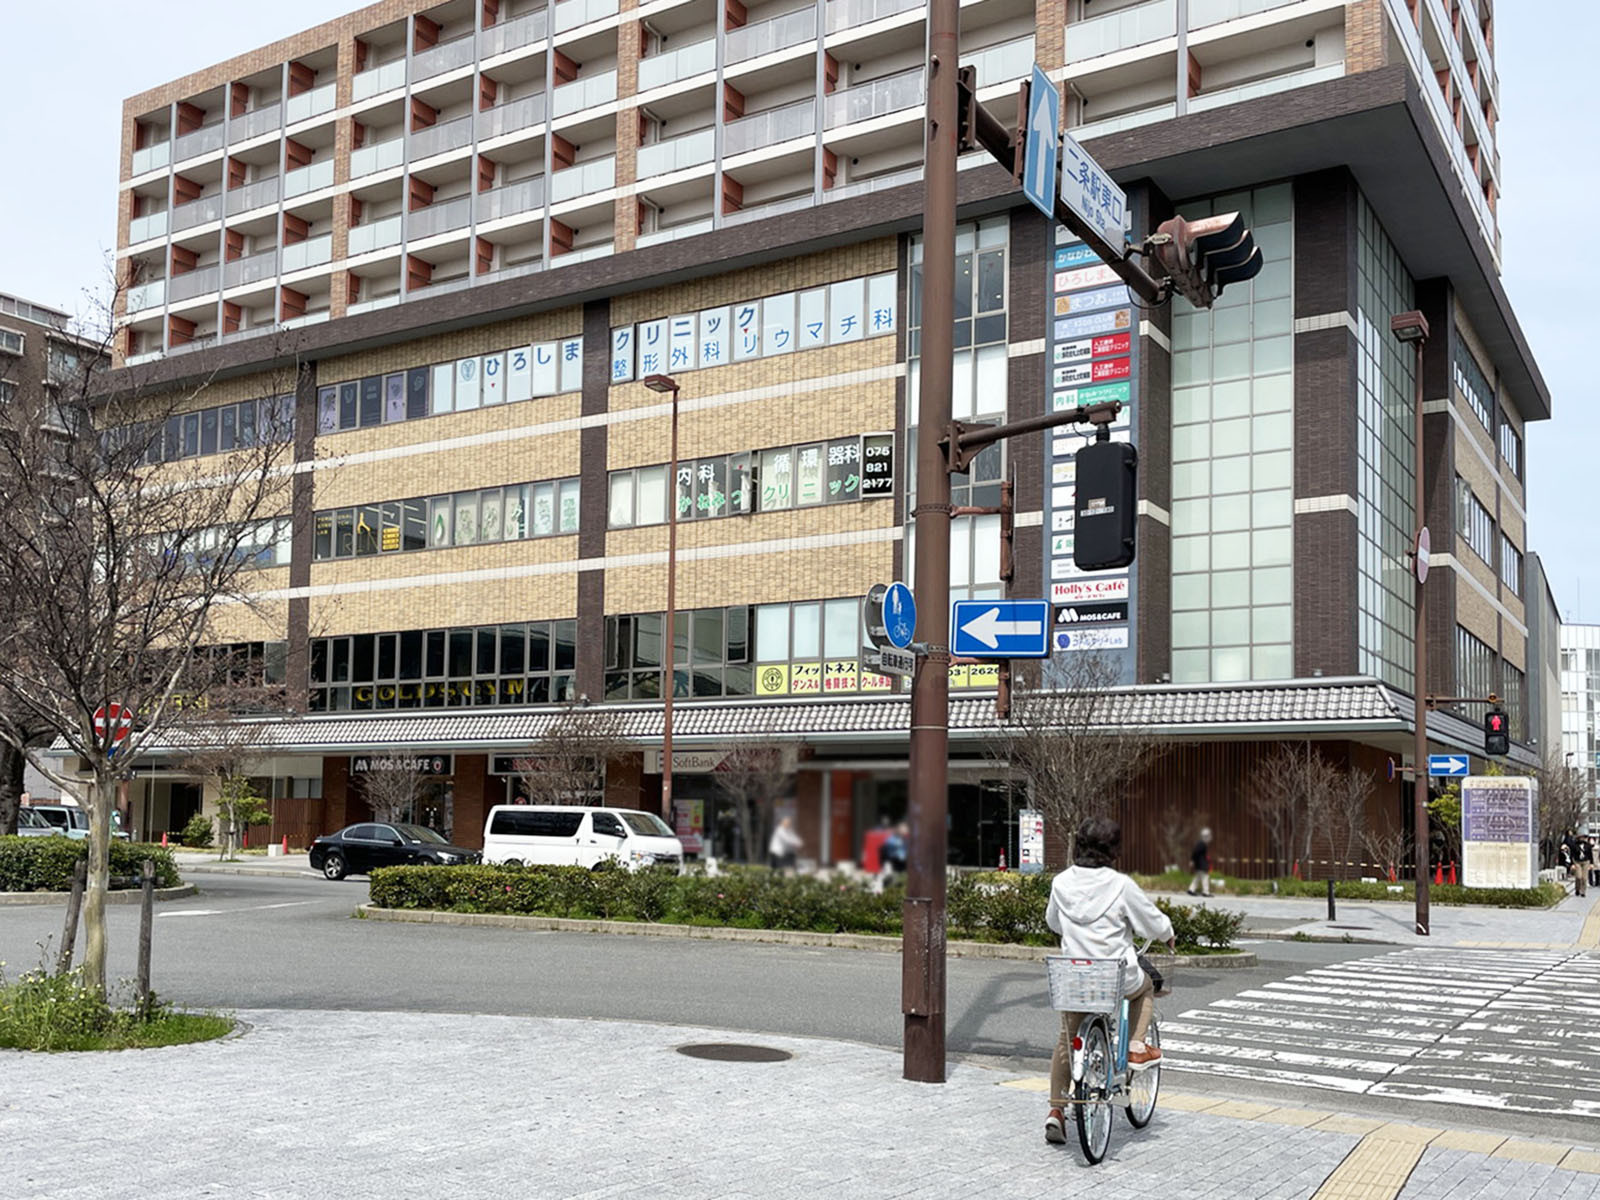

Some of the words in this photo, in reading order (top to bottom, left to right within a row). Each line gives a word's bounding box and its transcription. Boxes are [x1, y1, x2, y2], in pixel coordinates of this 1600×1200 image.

[1067, 148, 1122, 225] 二条駅東口
[486, 342, 579, 376] ひろしま
[616, 307, 754, 351] クリニック
[613, 341, 720, 379] 整形外科
[744, 308, 892, 354] リウマチ科
[677, 464, 715, 485] 内科
[774, 443, 861, 473] 循環器科
[866, 446, 890, 457] 075
[866, 461, 888, 473] 821
[1055, 583, 1092, 595] Holly's
[673, 756, 716, 769] SoftBank
